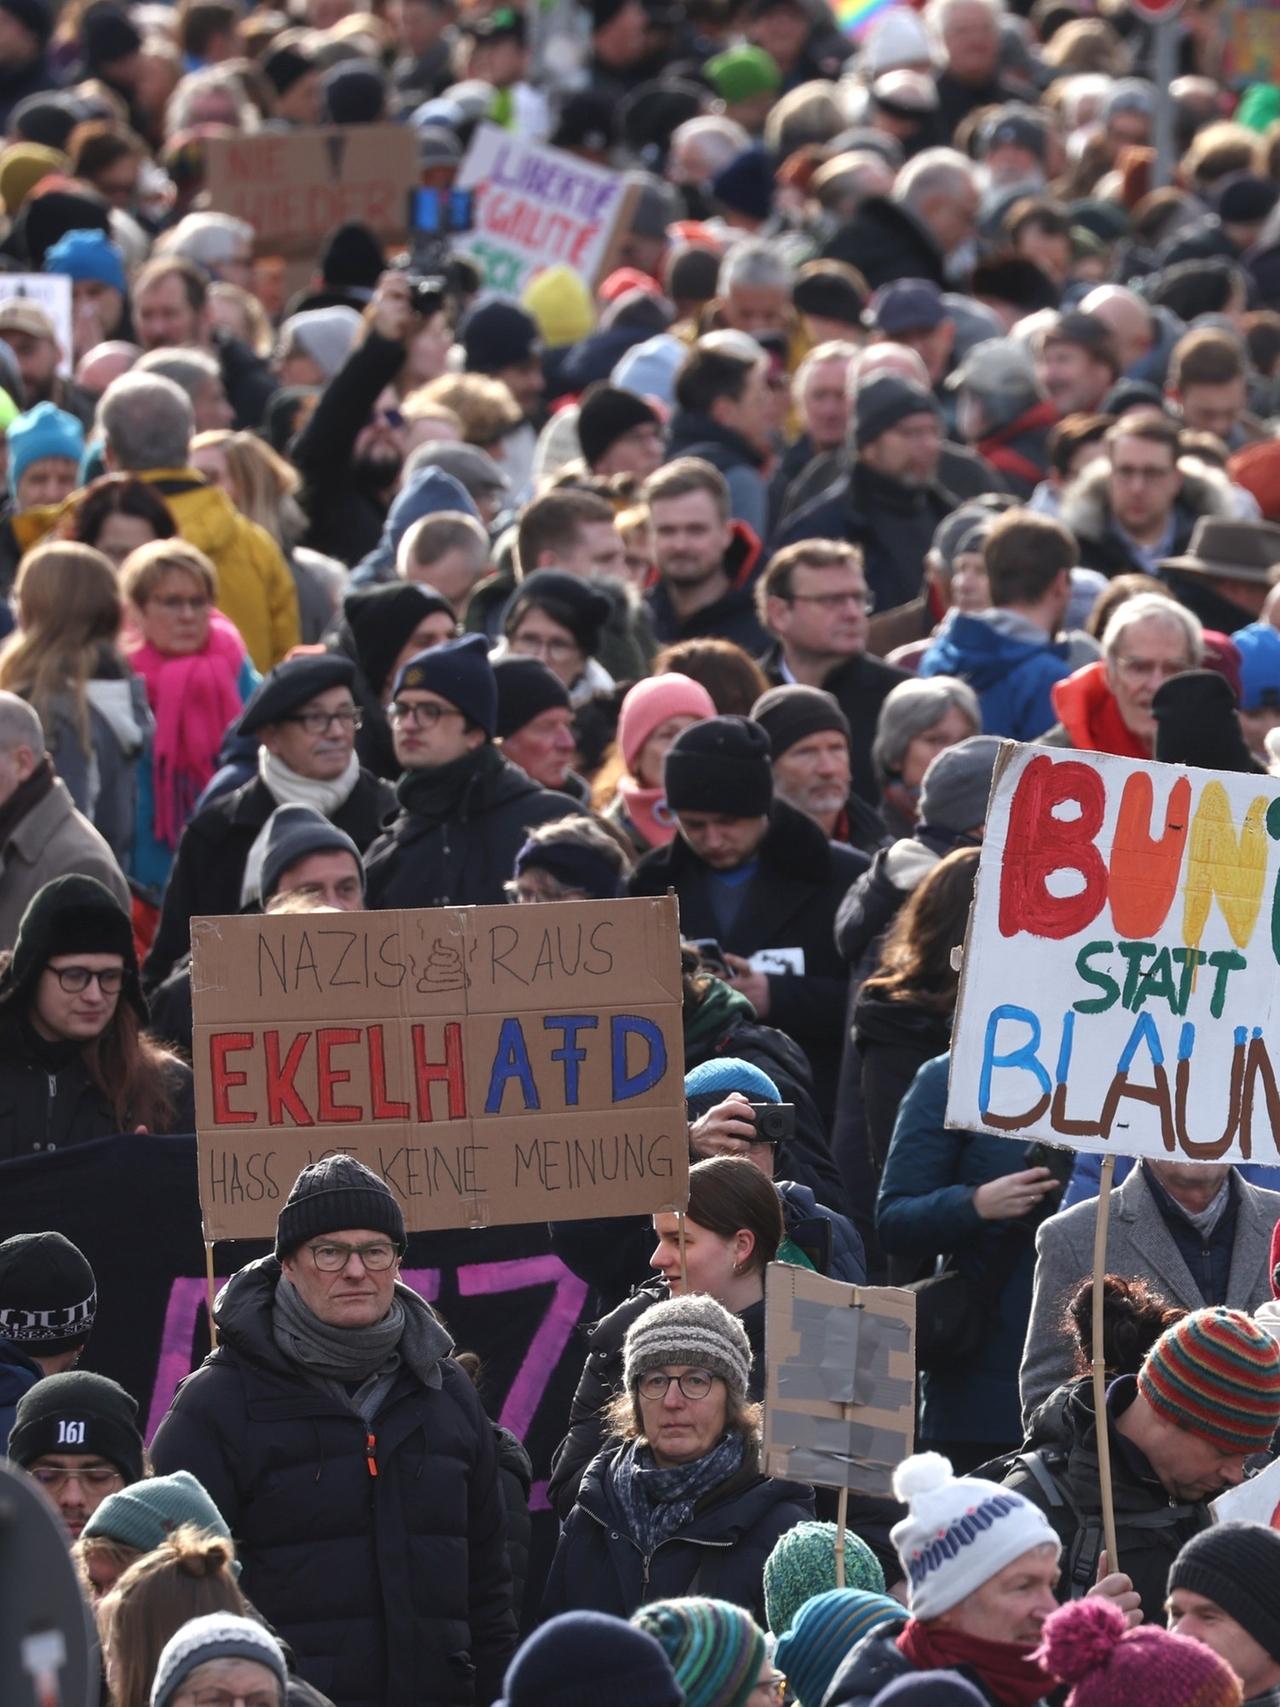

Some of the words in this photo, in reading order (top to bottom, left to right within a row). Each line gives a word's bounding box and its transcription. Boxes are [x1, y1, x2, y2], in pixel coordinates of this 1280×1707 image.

[258, 930, 406, 997] NAZIS
[488, 921, 614, 986] RAUS
[1072, 941, 1247, 1019] STATT
[210, 1149, 280, 1204] HASS
[379, 1146, 489, 1200] KEINE
[513, 1132, 674, 1192] MEINUNG
[57, 1420, 85, 1444] 161
